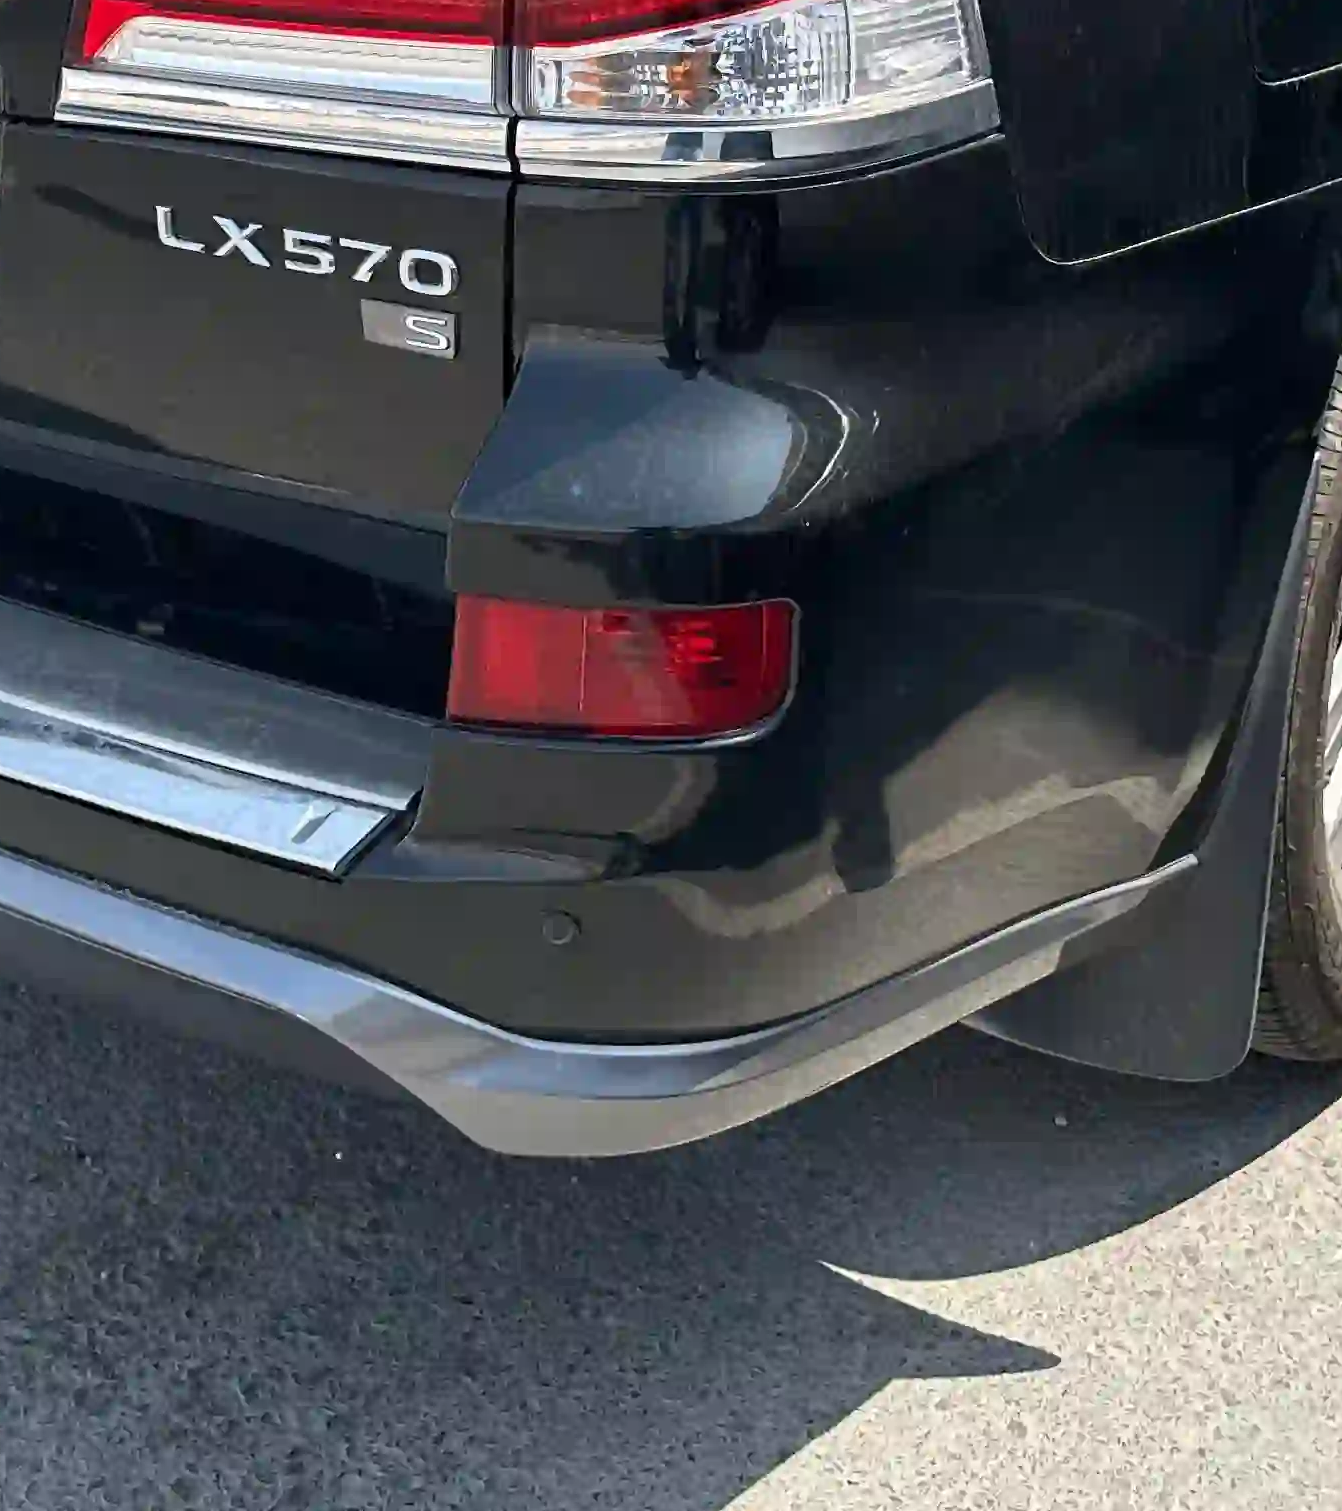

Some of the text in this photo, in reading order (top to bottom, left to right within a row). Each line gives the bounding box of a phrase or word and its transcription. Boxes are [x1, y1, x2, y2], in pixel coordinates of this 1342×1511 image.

[155, 204, 459, 297] LX 570
[404, 313, 450, 351] S
